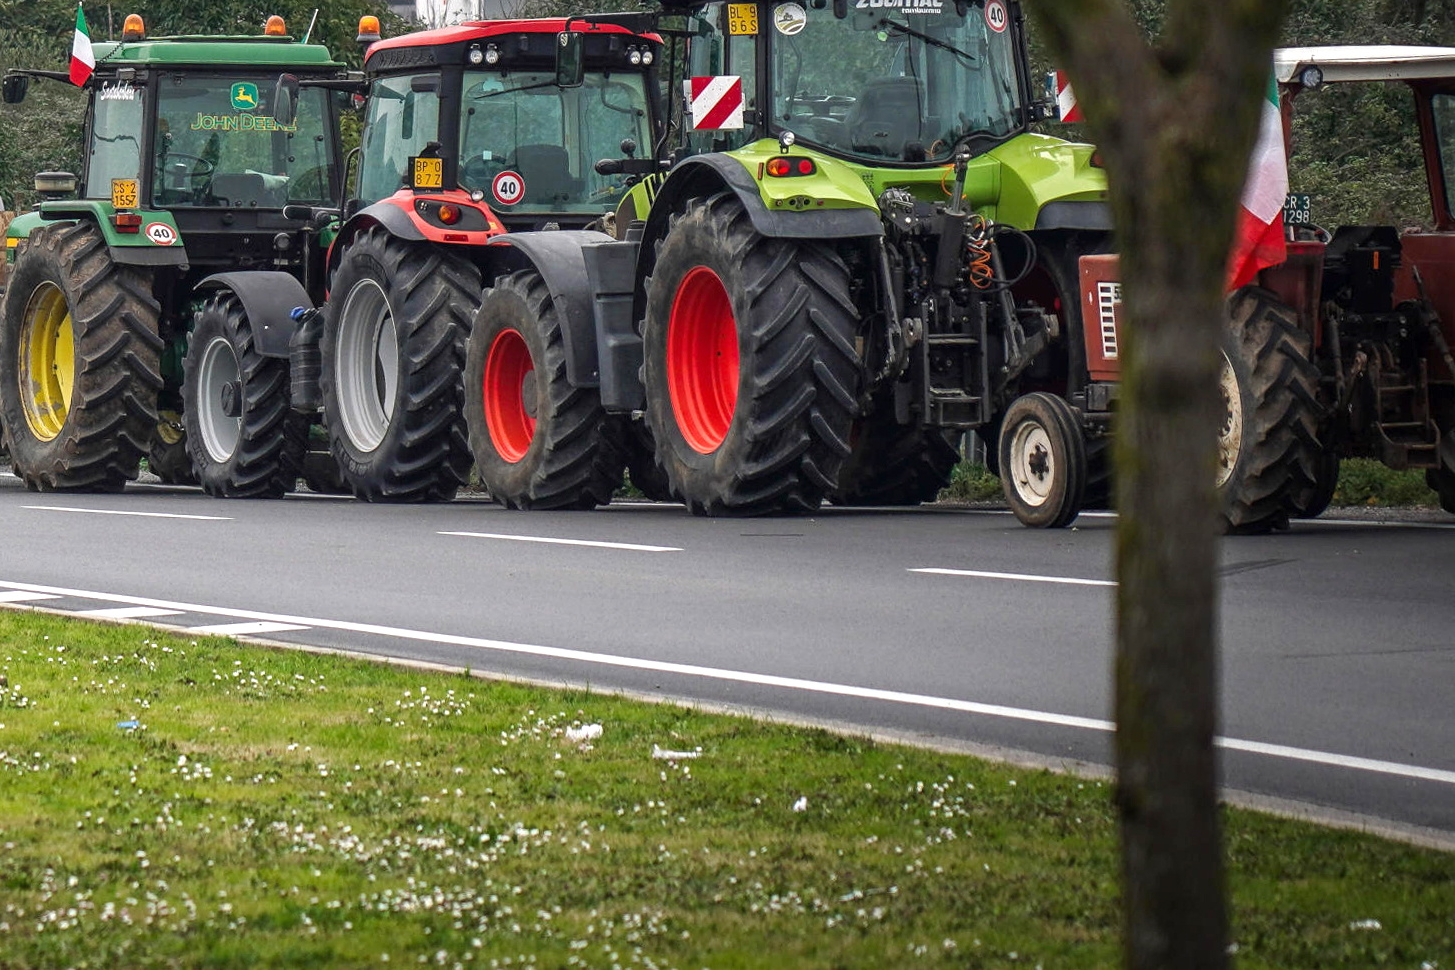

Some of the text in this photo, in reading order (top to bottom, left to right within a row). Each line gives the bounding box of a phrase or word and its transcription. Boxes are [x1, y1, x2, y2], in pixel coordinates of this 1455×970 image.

[729, 6, 744, 19] BL
[990, 7, 1003, 23] 40
[191, 112, 238, 130] JOHN
[415, 160, 428, 172] BP
[113, 182, 136, 194] CS 2
[500, 181, 516, 195] 40
[115, 194, 137, 206] 1557
[1283, 195, 1310, 210] CR 3
[1283, 210, 1310, 224] 1298
[153, 228, 170, 239] 40
